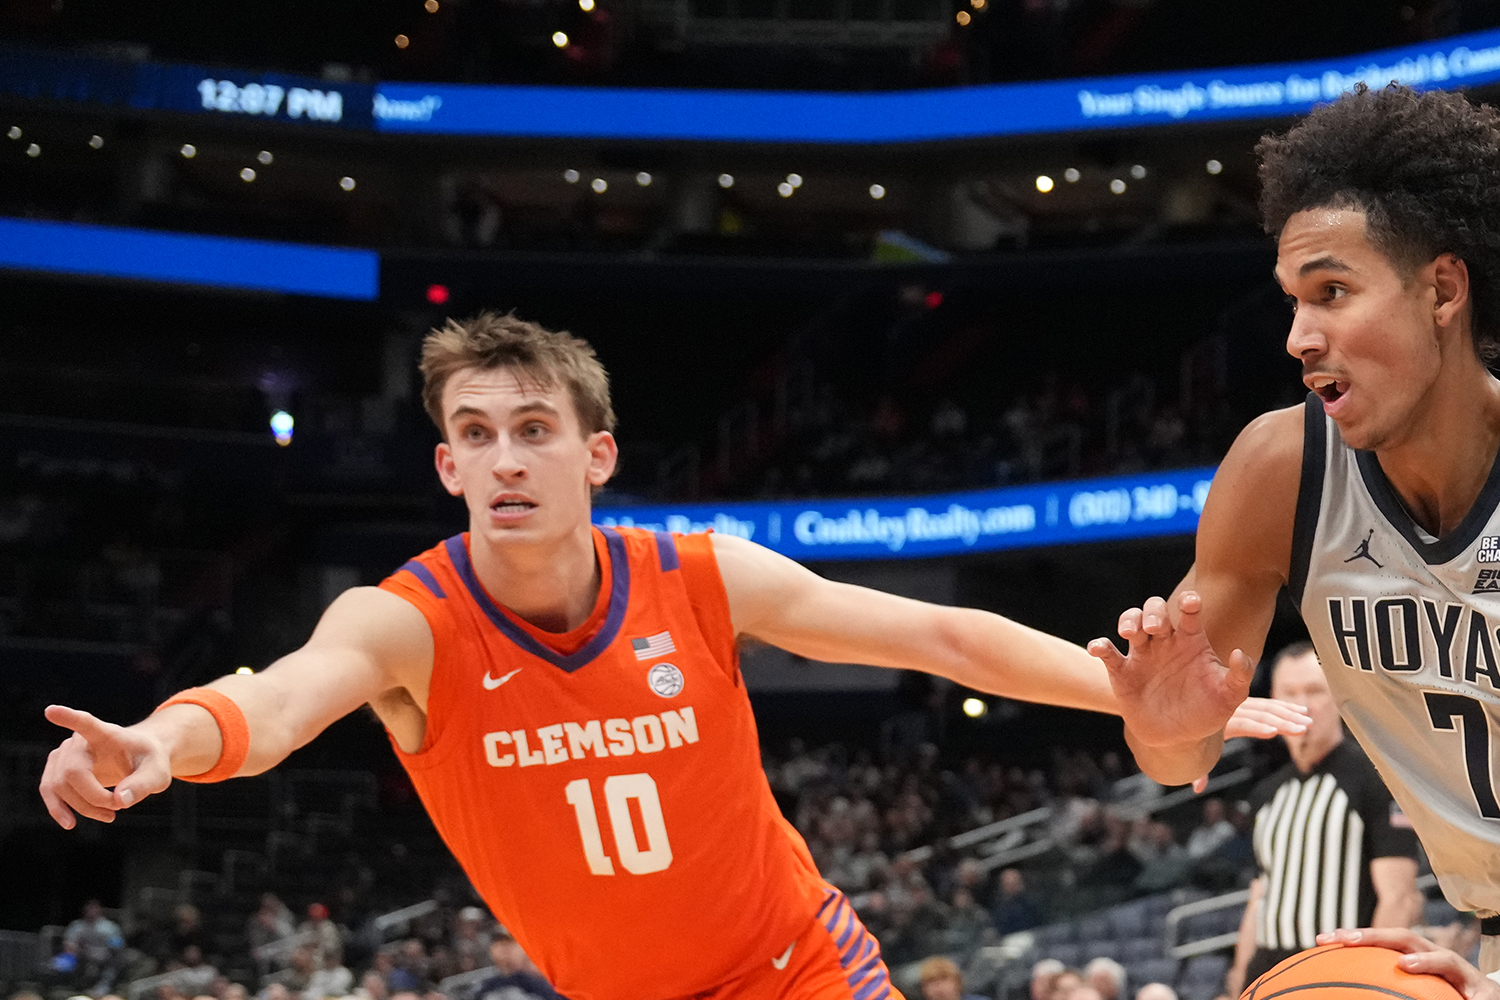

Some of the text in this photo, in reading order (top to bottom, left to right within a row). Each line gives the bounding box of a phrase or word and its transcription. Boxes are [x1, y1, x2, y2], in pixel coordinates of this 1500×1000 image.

[287, 87, 343, 123] PM
[1133, 82, 1206, 118] Single
[1206, 80, 1285, 109] Source
[1481, 536, 1499, 550] BE
[483, 706, 700, 768] CLEMSON
[565, 772, 673, 876] 10
